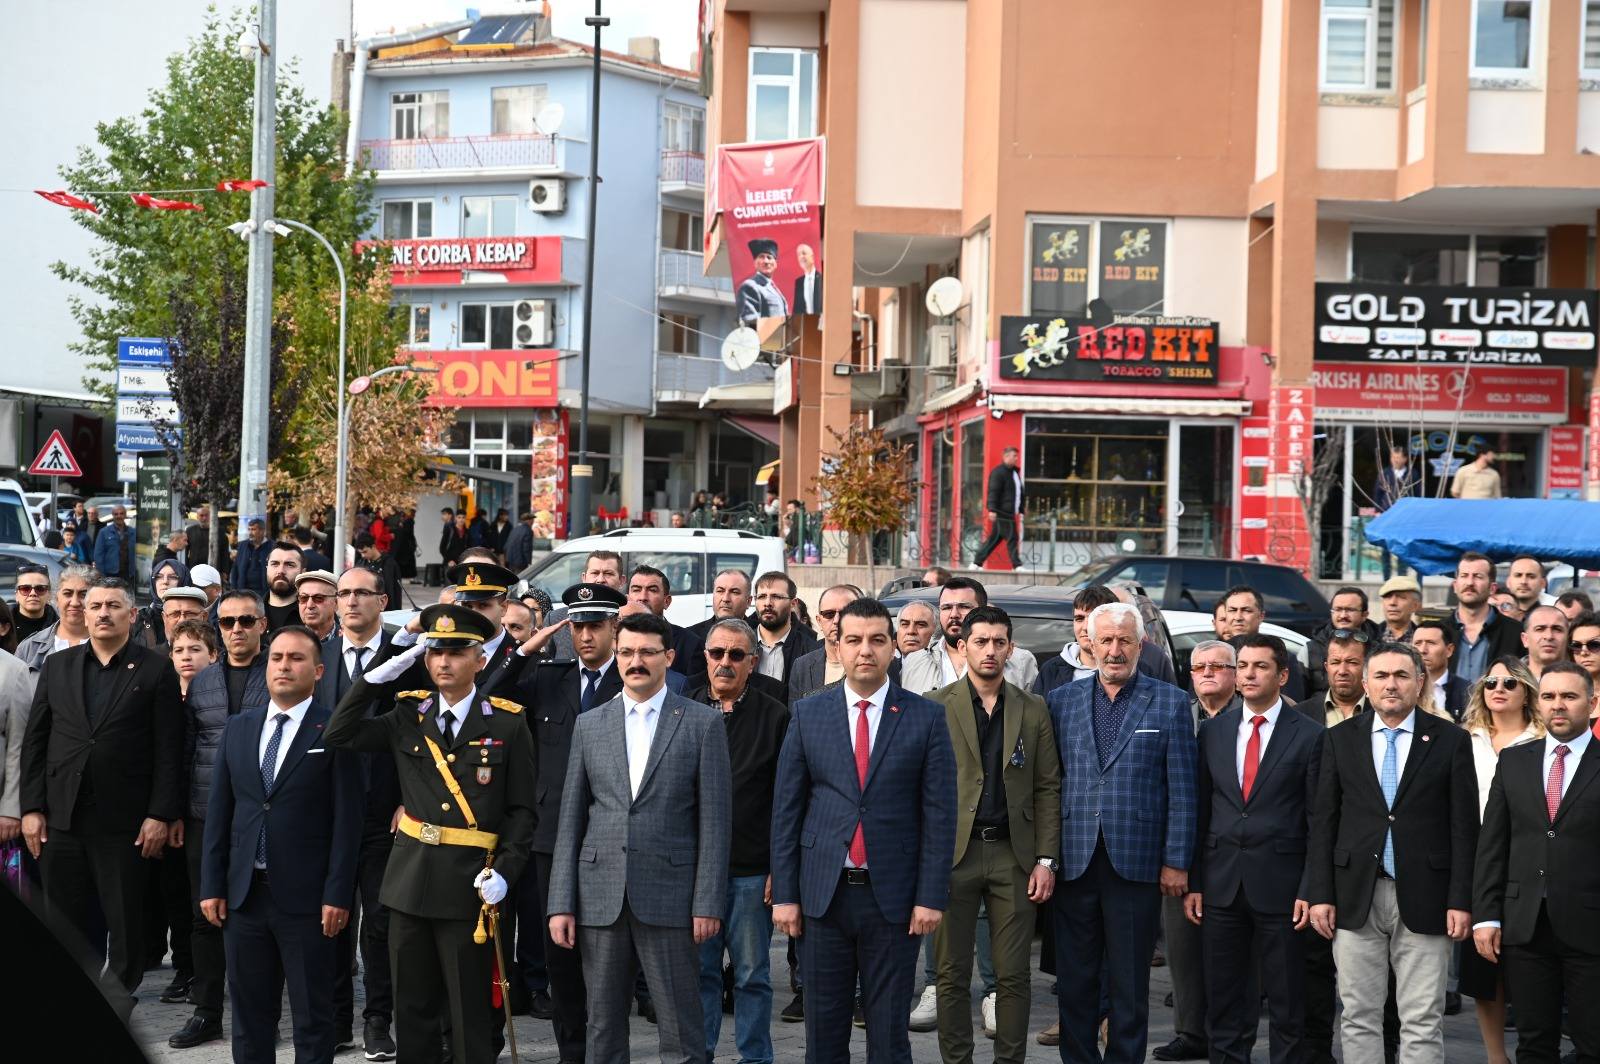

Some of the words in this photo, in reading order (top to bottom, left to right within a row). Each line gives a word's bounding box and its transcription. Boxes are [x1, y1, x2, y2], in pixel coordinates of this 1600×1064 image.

[745, 188, 794, 204] İLELEBET
[733, 200, 809, 219] CUMHURİYET
[417, 244, 472, 266] ÇORBA
[476, 242, 526, 263] KEBAP
[1033, 267, 1059, 281] RED
[1104, 265, 1131, 280] RED
[1326, 293, 1425, 323] GOLD
[1443, 290, 1590, 327] TURİZM
[1076, 325, 1146, 361] RED
[1368, 348, 1448, 361] ZAFER
[1453, 350, 1542, 364] TURİZM
[1103, 365, 1162, 377] TOBACCO
[1168, 367, 1213, 379] SHISHA
[1312, 371, 1361, 389] RKISH
[1365, 372, 1440, 391] AIRLINES
[556, 418, 566, 530] ABONE
